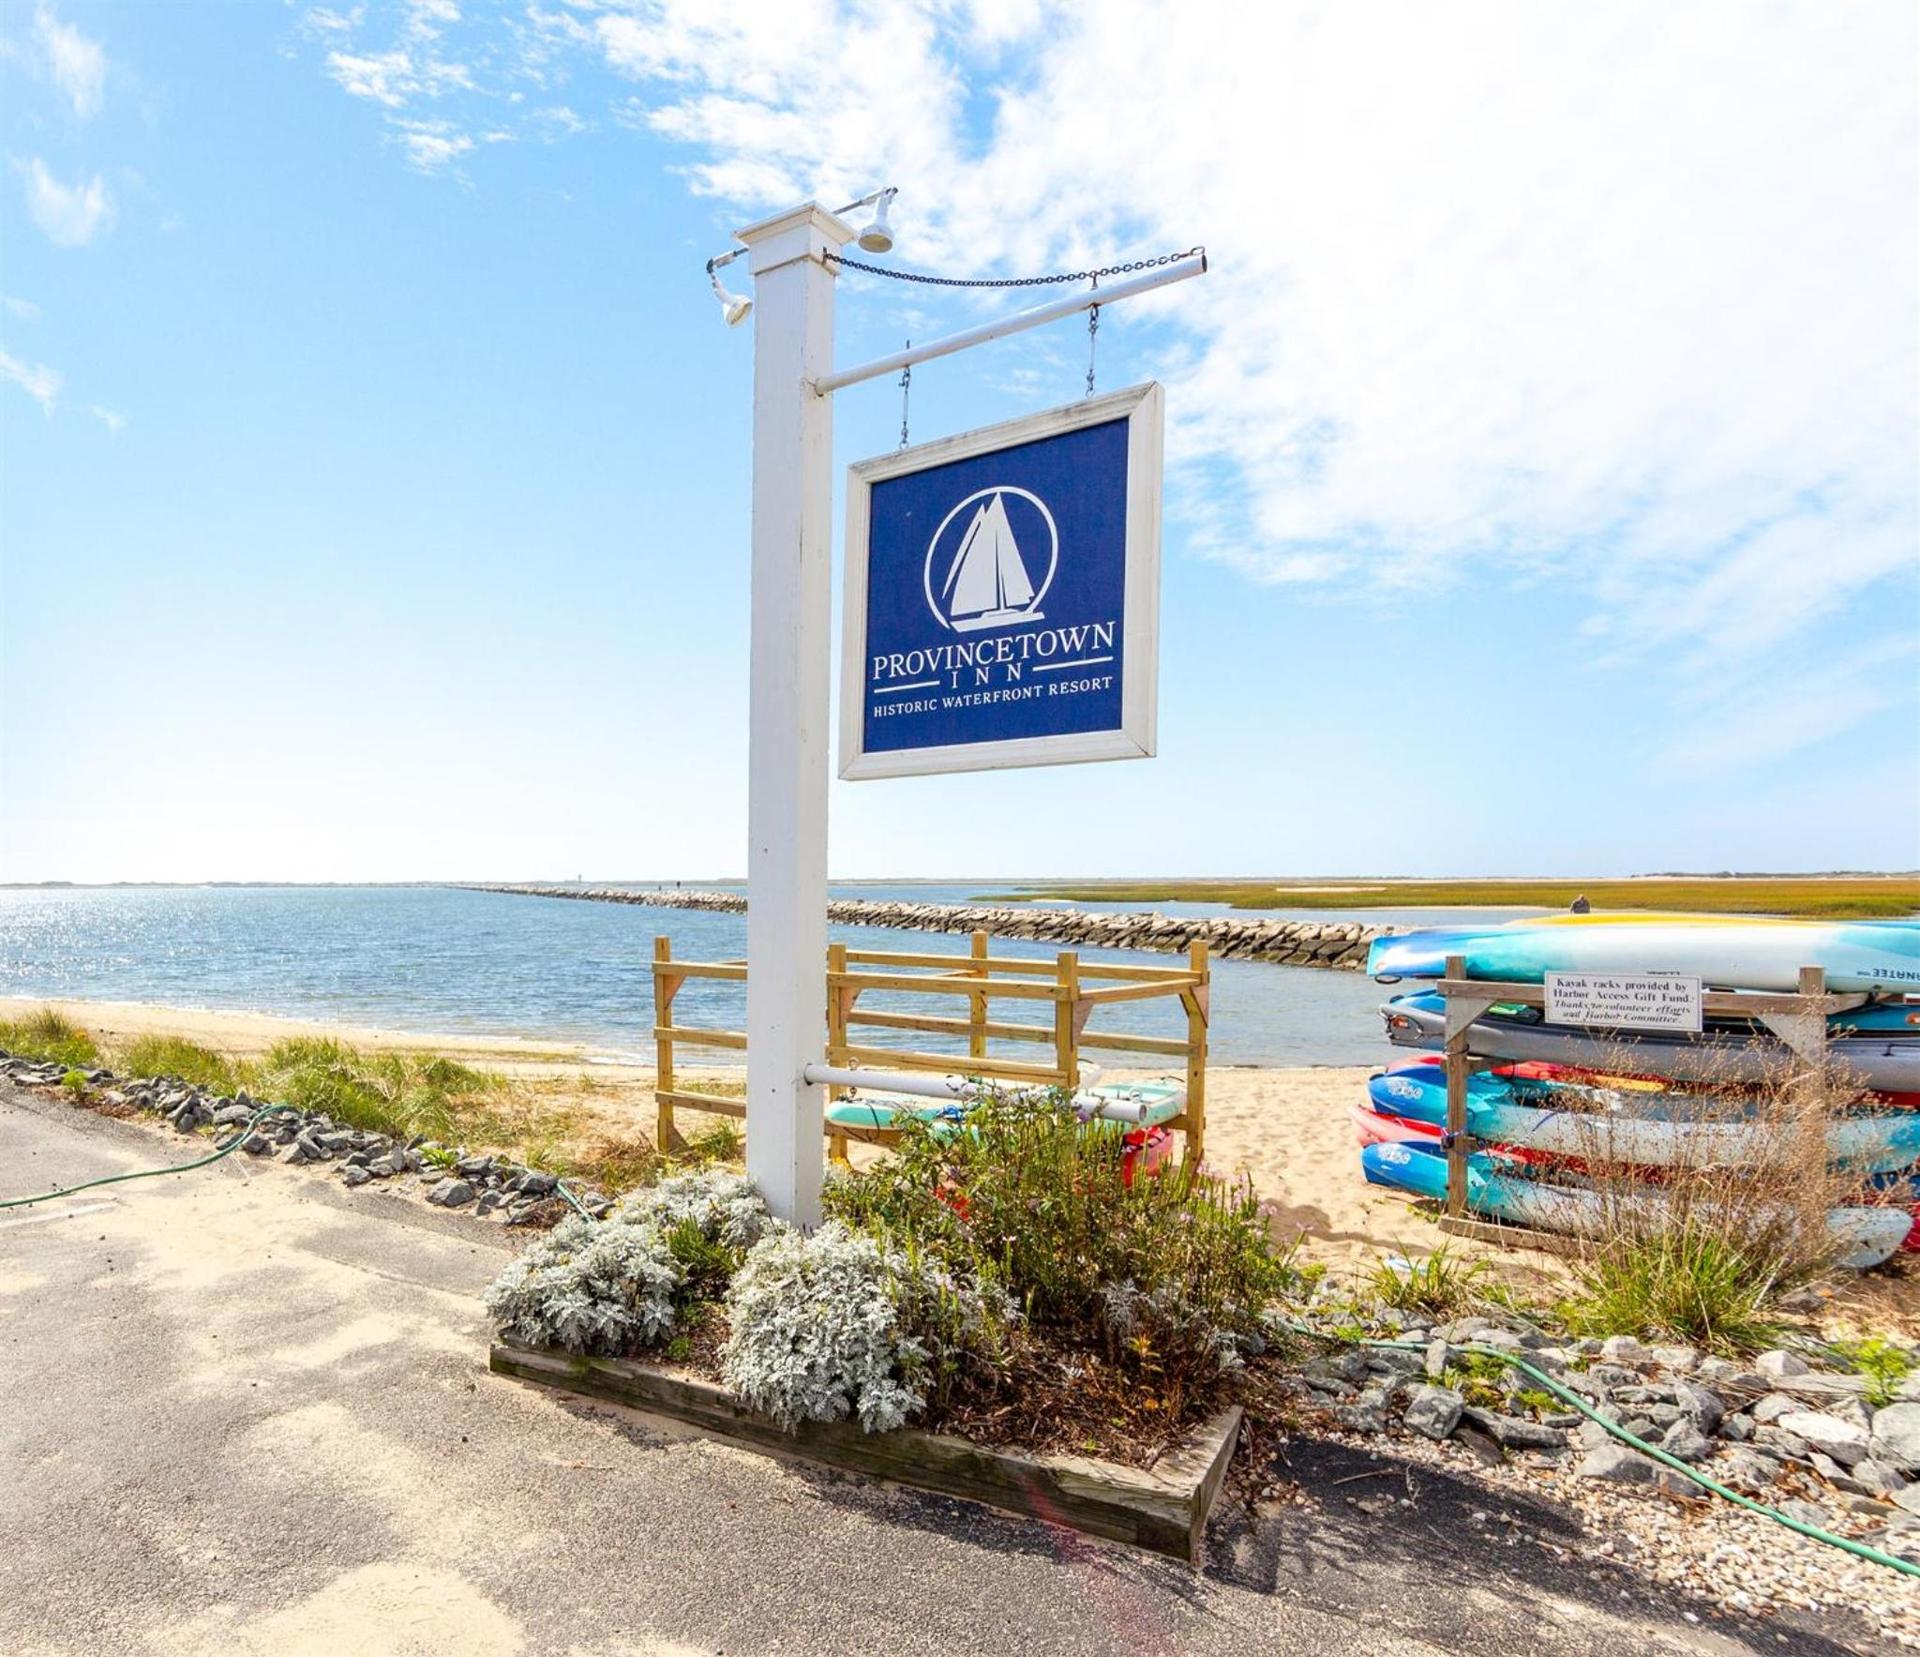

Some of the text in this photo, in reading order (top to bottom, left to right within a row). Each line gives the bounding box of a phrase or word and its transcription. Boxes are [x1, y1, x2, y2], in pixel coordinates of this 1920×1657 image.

[873, 621, 1116, 680] PROVINCETOWN
[874, 677, 1112, 718] HISTORIC WATERFRONT RESORT
[1557, 978, 1688, 994] Kayak racks provided by
[1553, 988, 1590, 999] Harbor
[1597, 991, 1630, 1001] Access
[1635, 993, 1656, 1002] Gift
[1604, 1002, 1651, 1012] volunteer
[1655, 1006, 1690, 1015] efforts
